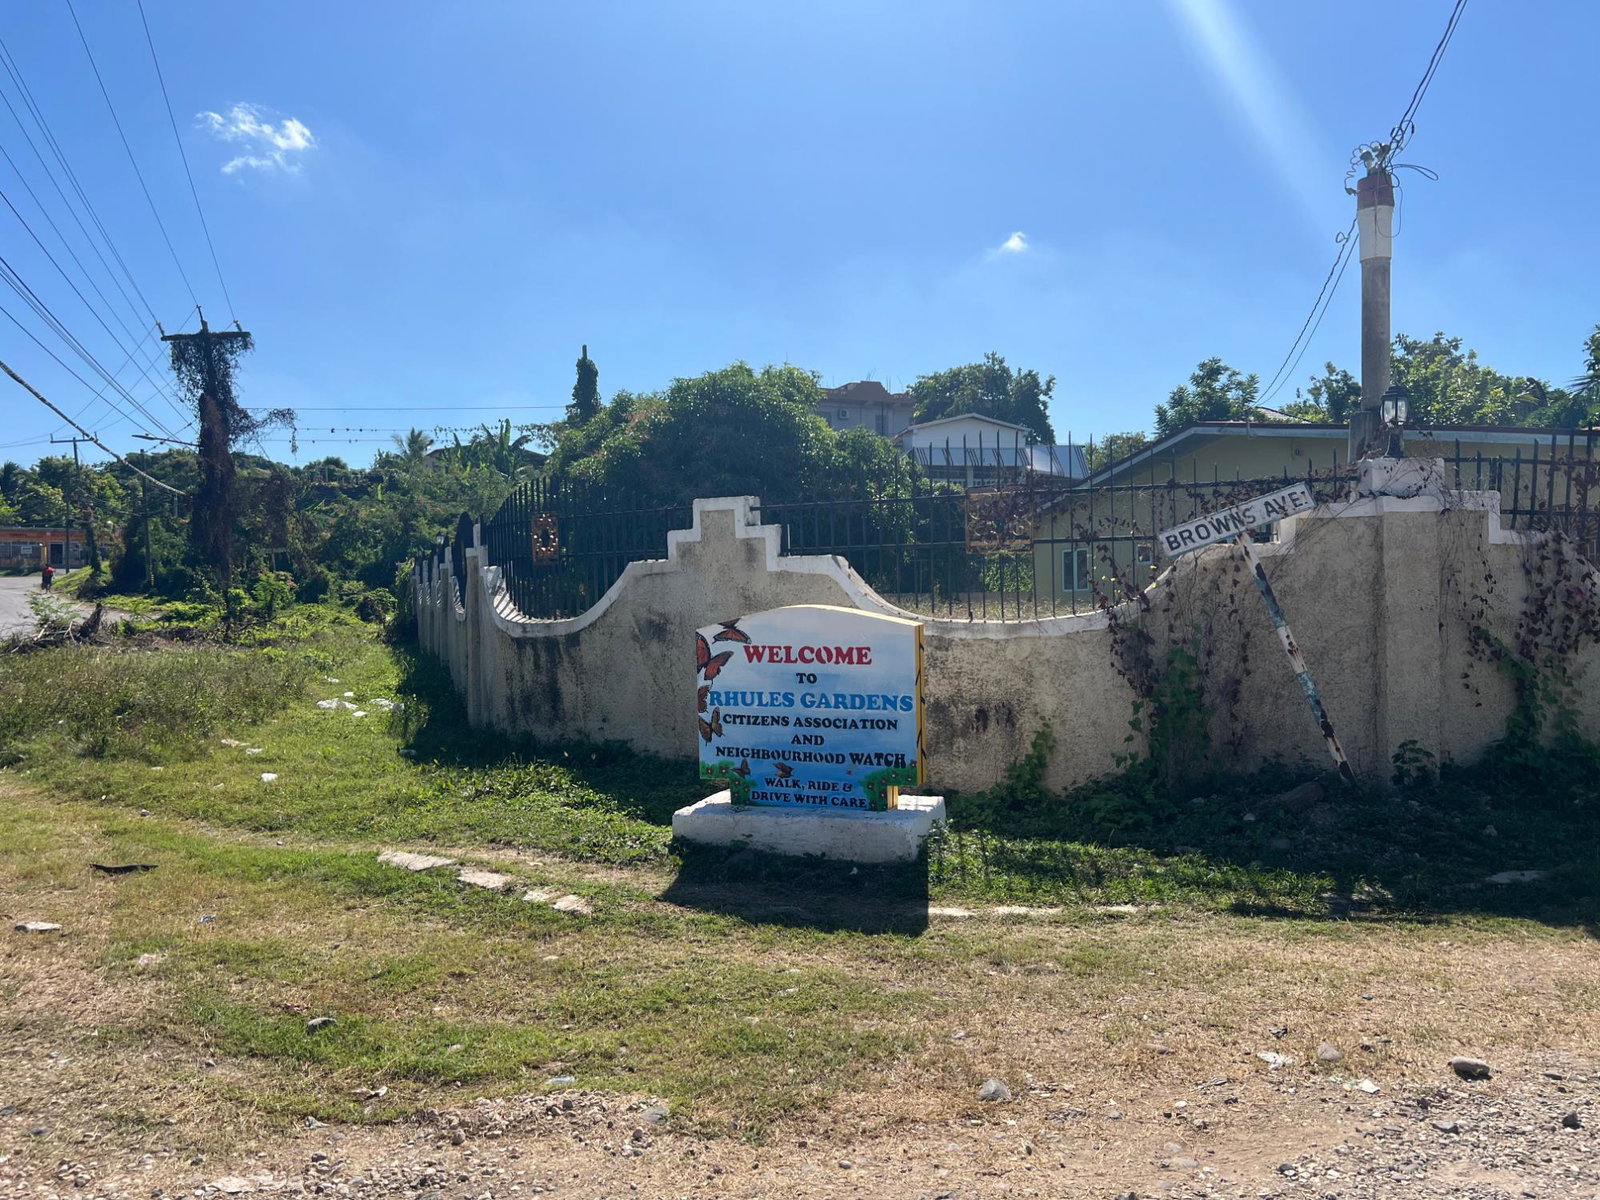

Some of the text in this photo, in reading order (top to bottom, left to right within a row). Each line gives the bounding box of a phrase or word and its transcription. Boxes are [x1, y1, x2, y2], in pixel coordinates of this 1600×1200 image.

[1165, 506, 1257, 551] BROWNS
[743, 645, 872, 665] WELCOME
[796, 672, 817, 684] TO
[709, 691, 913, 712] RHULES GARDENS
[722, 713, 898, 730] CITIZENS ASSOCIATION
[791, 734, 825, 746] AND
[715, 746, 906, 768] NEIGHBOURHOOD WATCH
[764, 777, 853, 792] WALK, RIDE &
[751, 790, 867, 808] DRIVE WITH CARE
